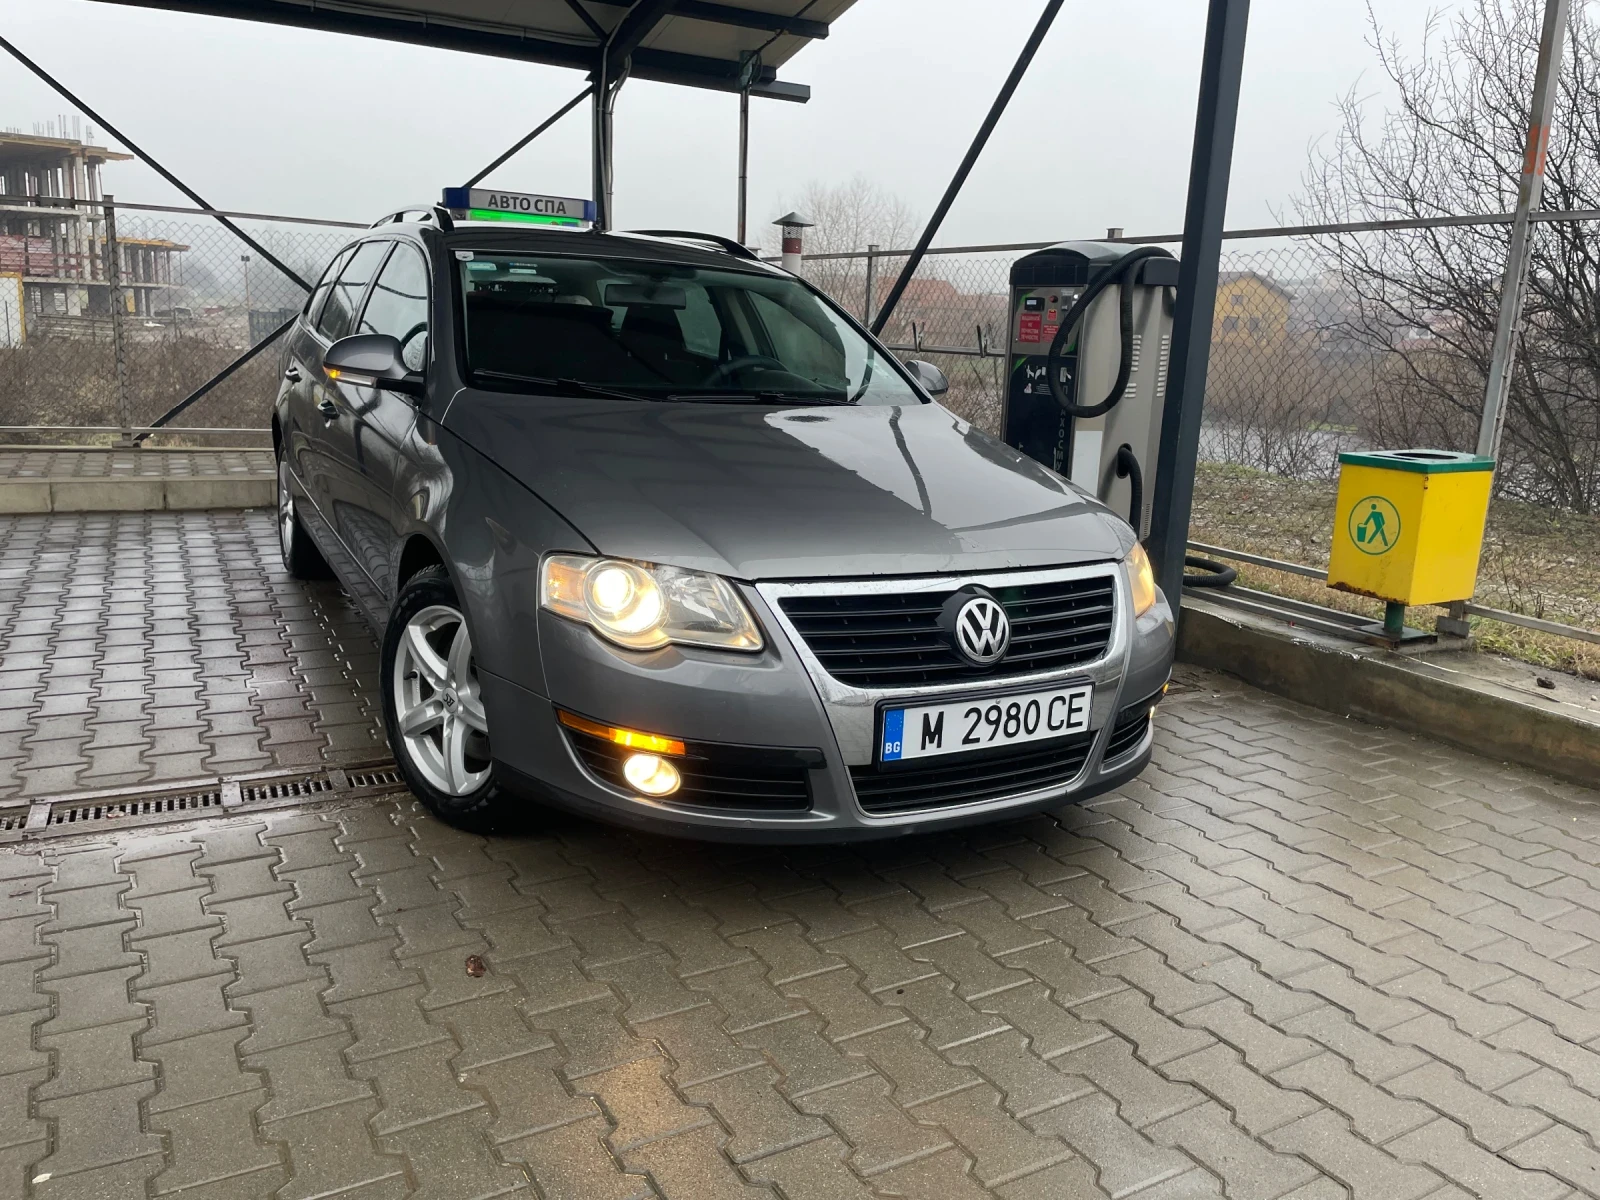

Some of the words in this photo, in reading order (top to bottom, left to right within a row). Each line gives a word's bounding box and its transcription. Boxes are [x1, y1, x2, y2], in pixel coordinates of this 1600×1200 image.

[488, 194, 531, 211] АВТО
[534, 199, 567, 214] СПА
[921, 711, 944, 751] M
[962, 699, 1041, 745] 2980
[1047, 692, 1086, 732] CE
[885, 741, 901, 755] BG
